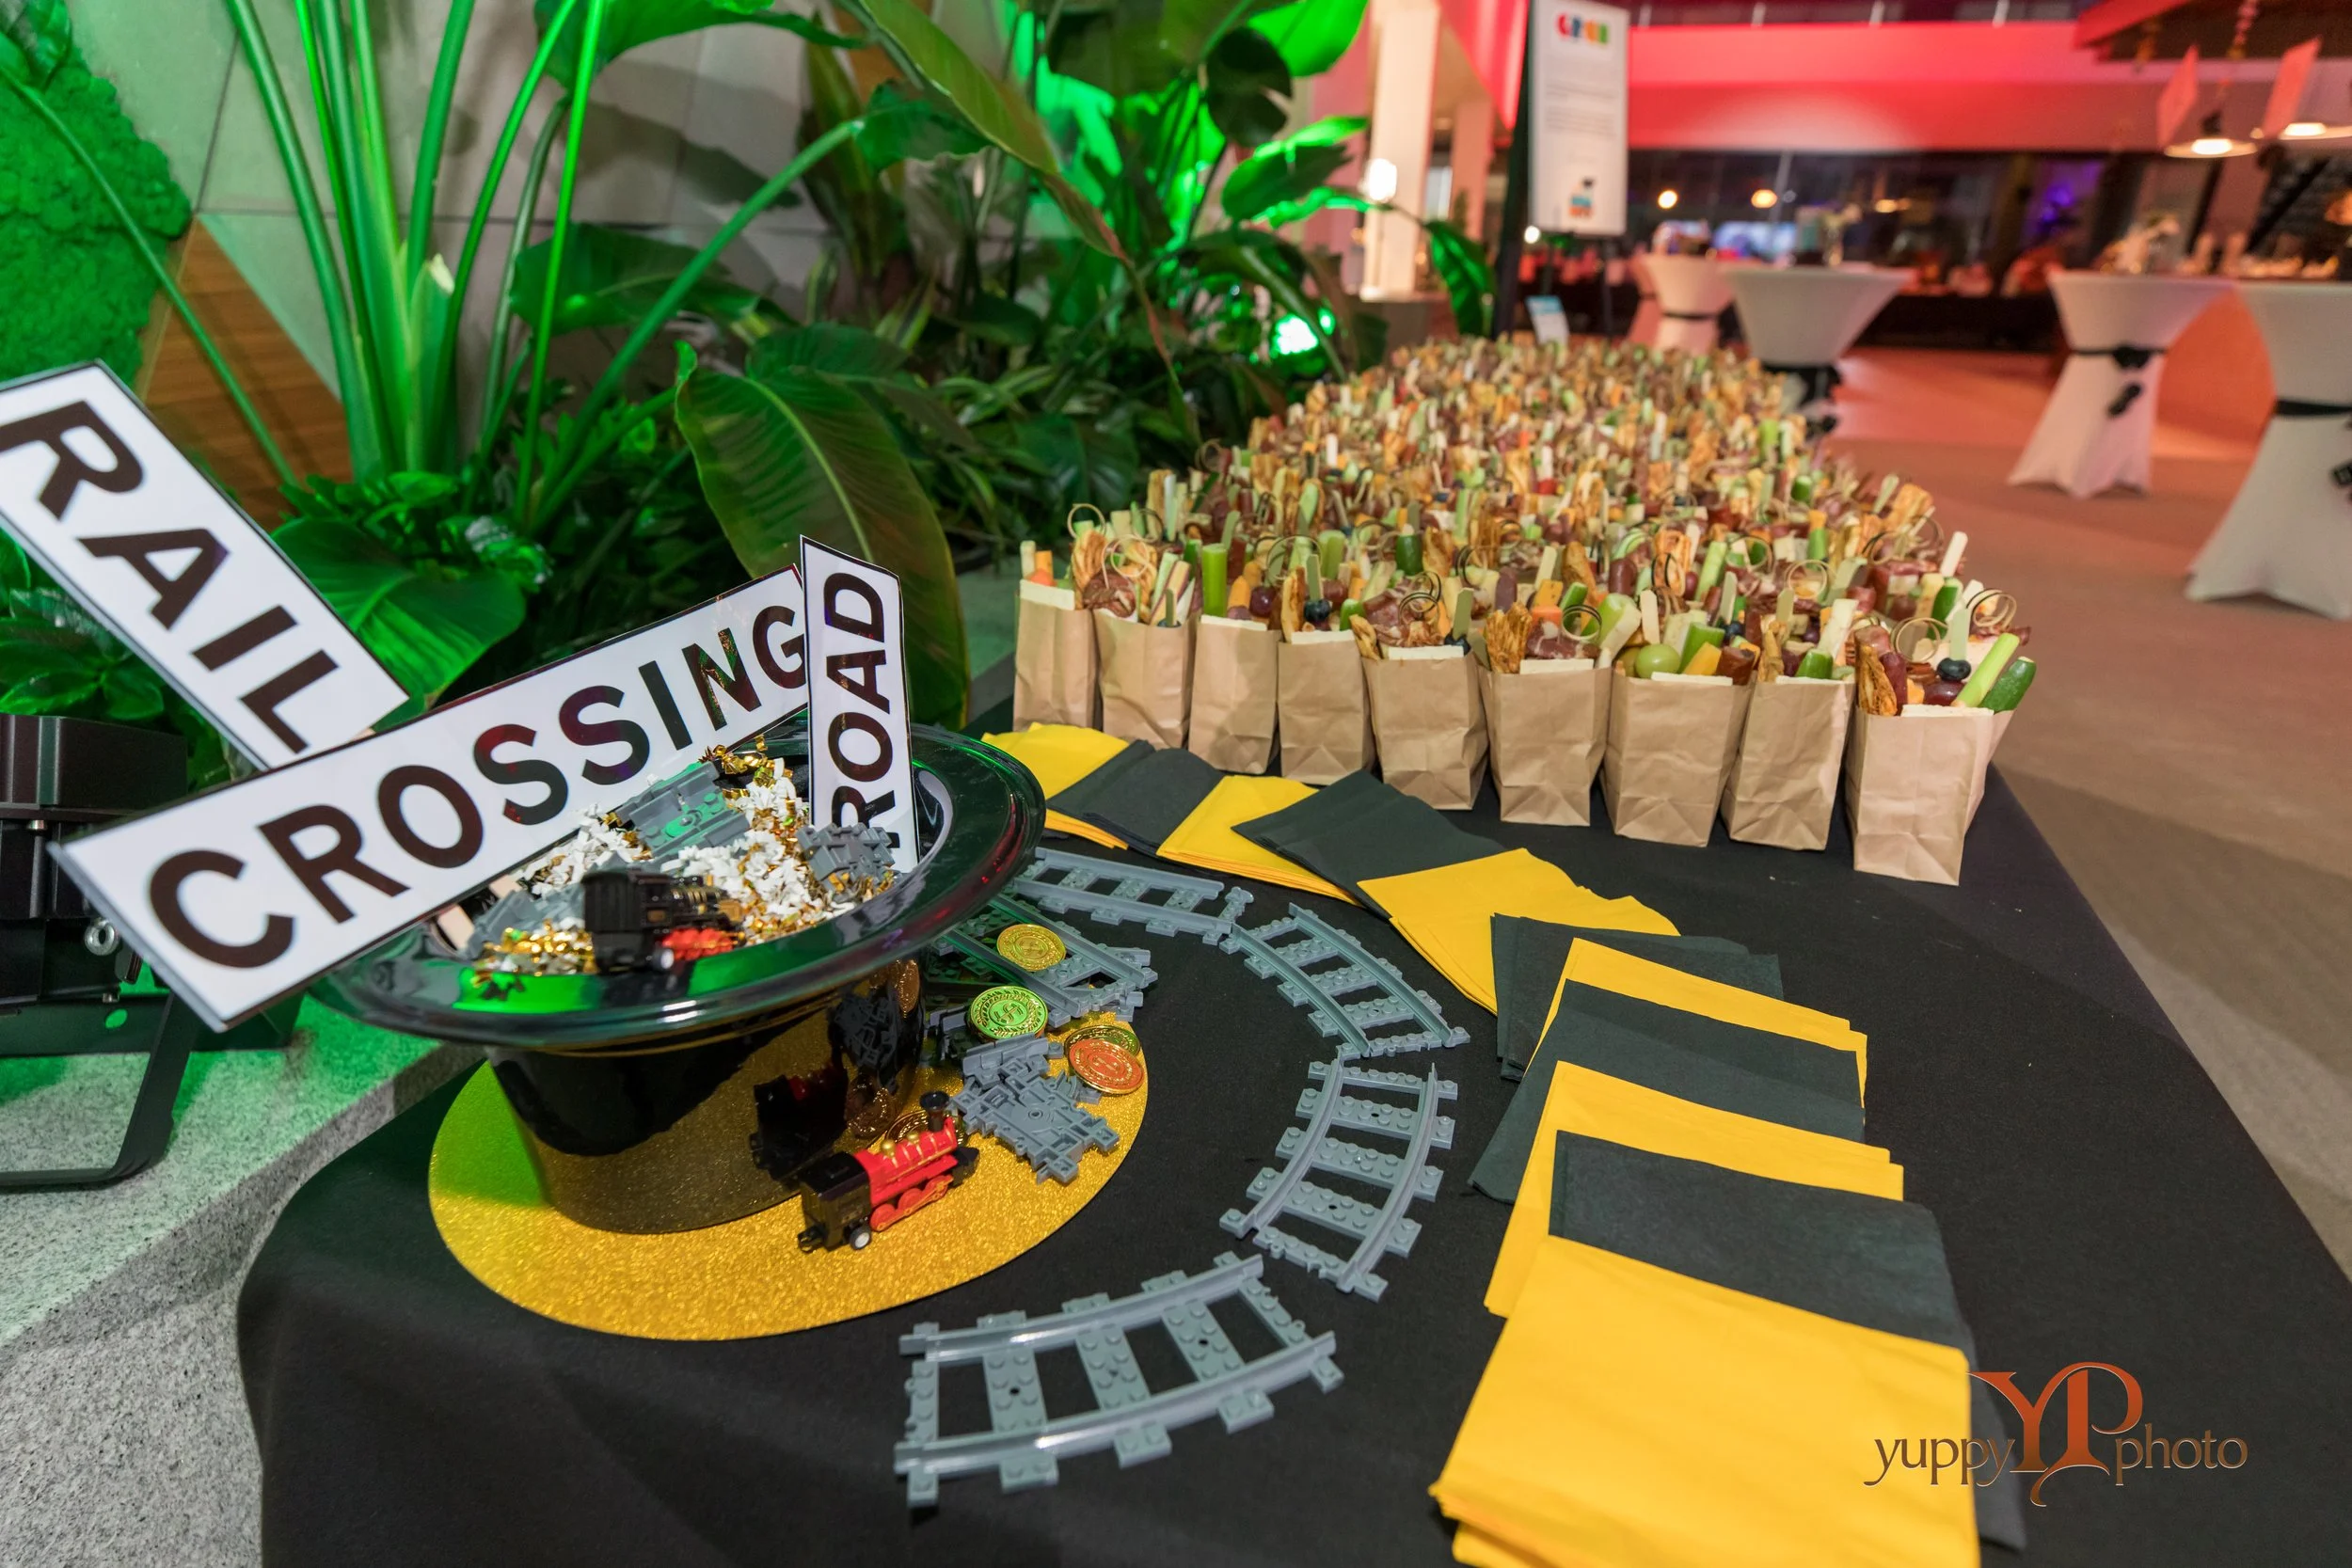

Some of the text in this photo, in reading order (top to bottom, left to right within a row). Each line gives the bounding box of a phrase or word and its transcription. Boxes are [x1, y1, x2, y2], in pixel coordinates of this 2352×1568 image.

[0, 401, 340, 754] RAIL
[824, 573, 900, 848] ROAD
[148, 603, 806, 969] CROSSING
